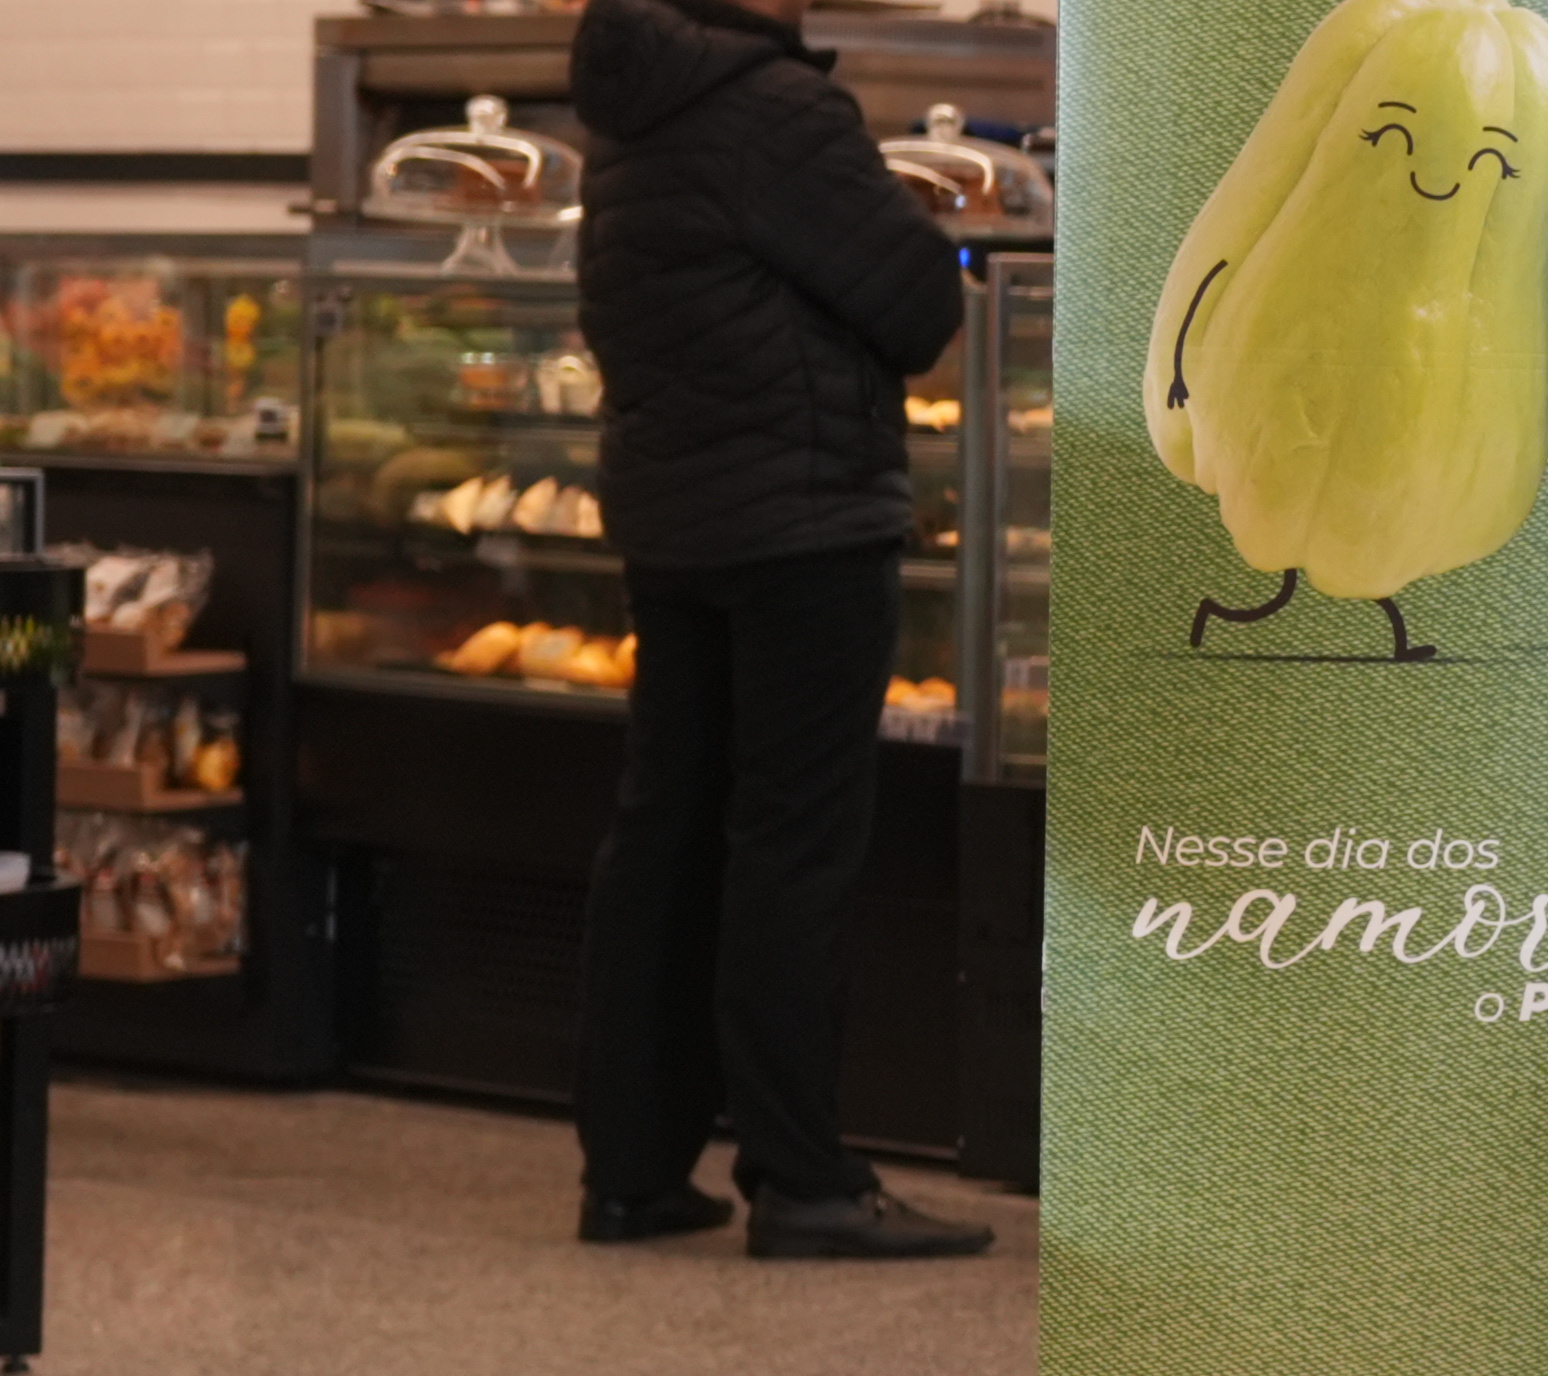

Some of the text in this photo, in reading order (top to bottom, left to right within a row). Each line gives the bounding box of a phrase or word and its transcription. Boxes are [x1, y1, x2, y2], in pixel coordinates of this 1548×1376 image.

[1135, 825, 1501, 870] Nesse dia dos
[1475, 990, 1505, 1023] o
